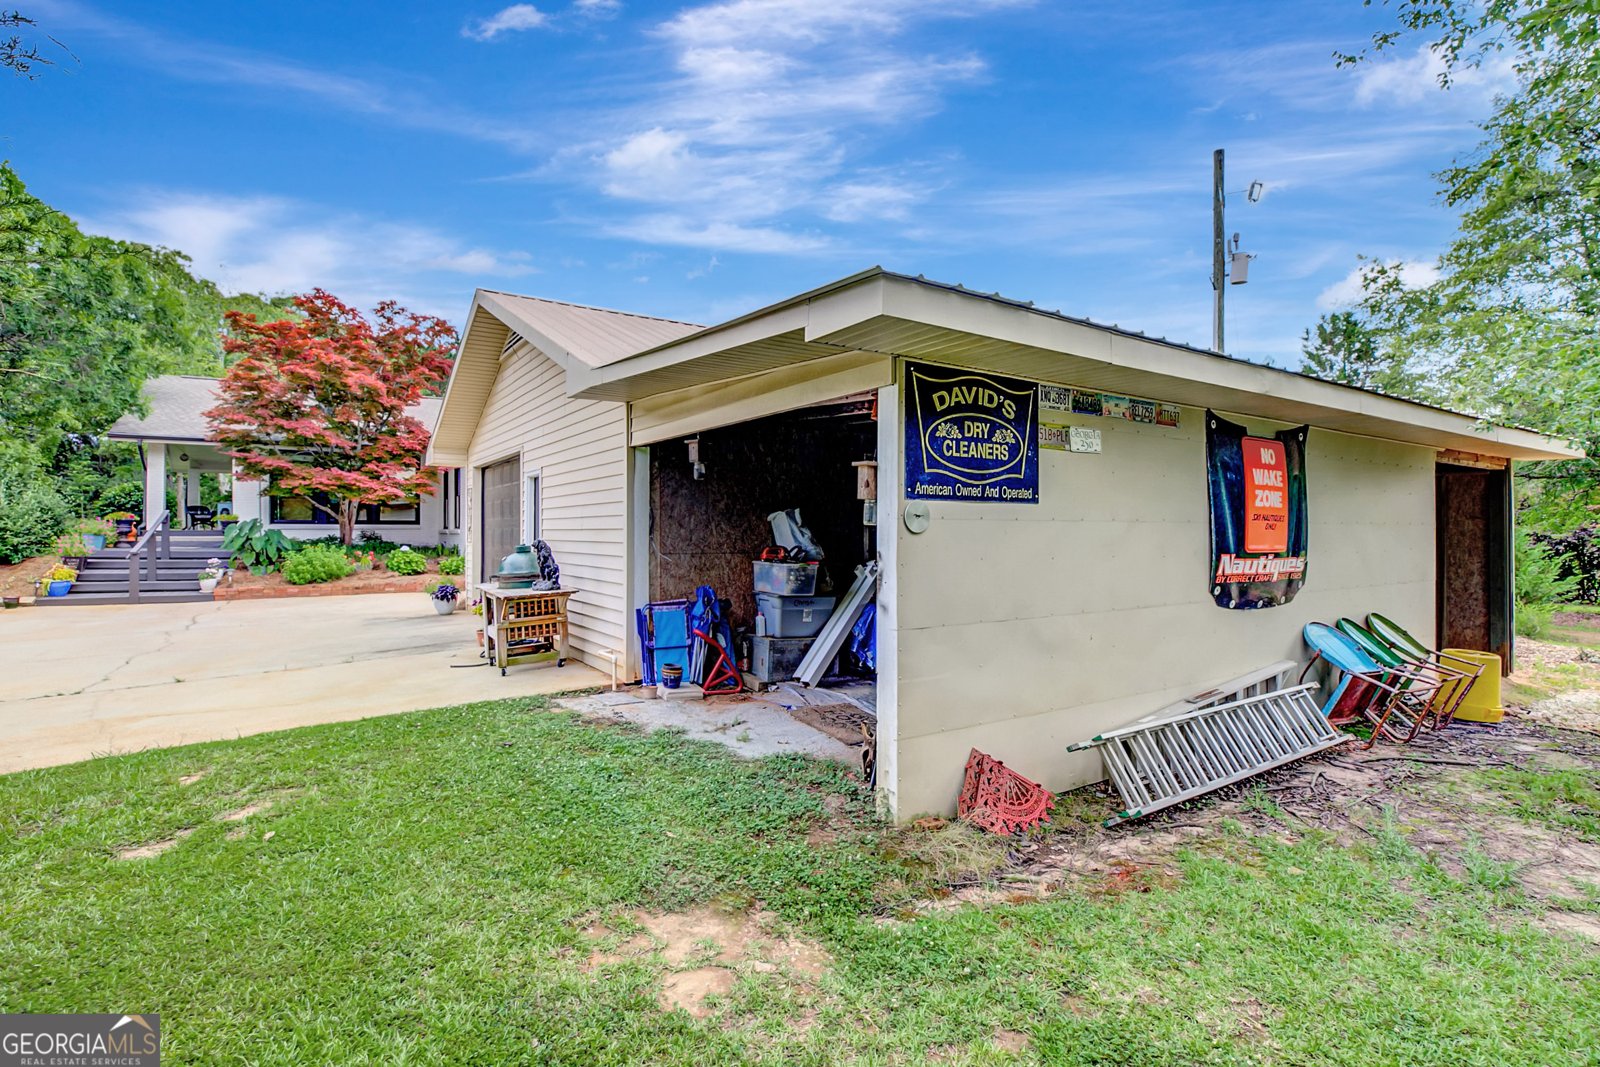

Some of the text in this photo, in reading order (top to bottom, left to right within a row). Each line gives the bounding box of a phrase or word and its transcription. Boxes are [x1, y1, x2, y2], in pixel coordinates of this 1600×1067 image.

[932, 386, 1017, 420] DAVID'S
[964, 420, 990, 439] DRY
[943, 440, 1009, 461] CLEANERS
[1260, 447, 1276, 465] NO
[1252, 468, 1283, 487] WAKE
[915, 482, 1033, 500] American Owned And Operated
[1254, 489, 1283, 508] ZONE
[1216, 553, 1306, 583] Nautiques
[1216, 575, 1226, 584] BY
[1226, 574, 1253, 583] CORRECT
[1255, 574, 1273, 582] CRAFT
